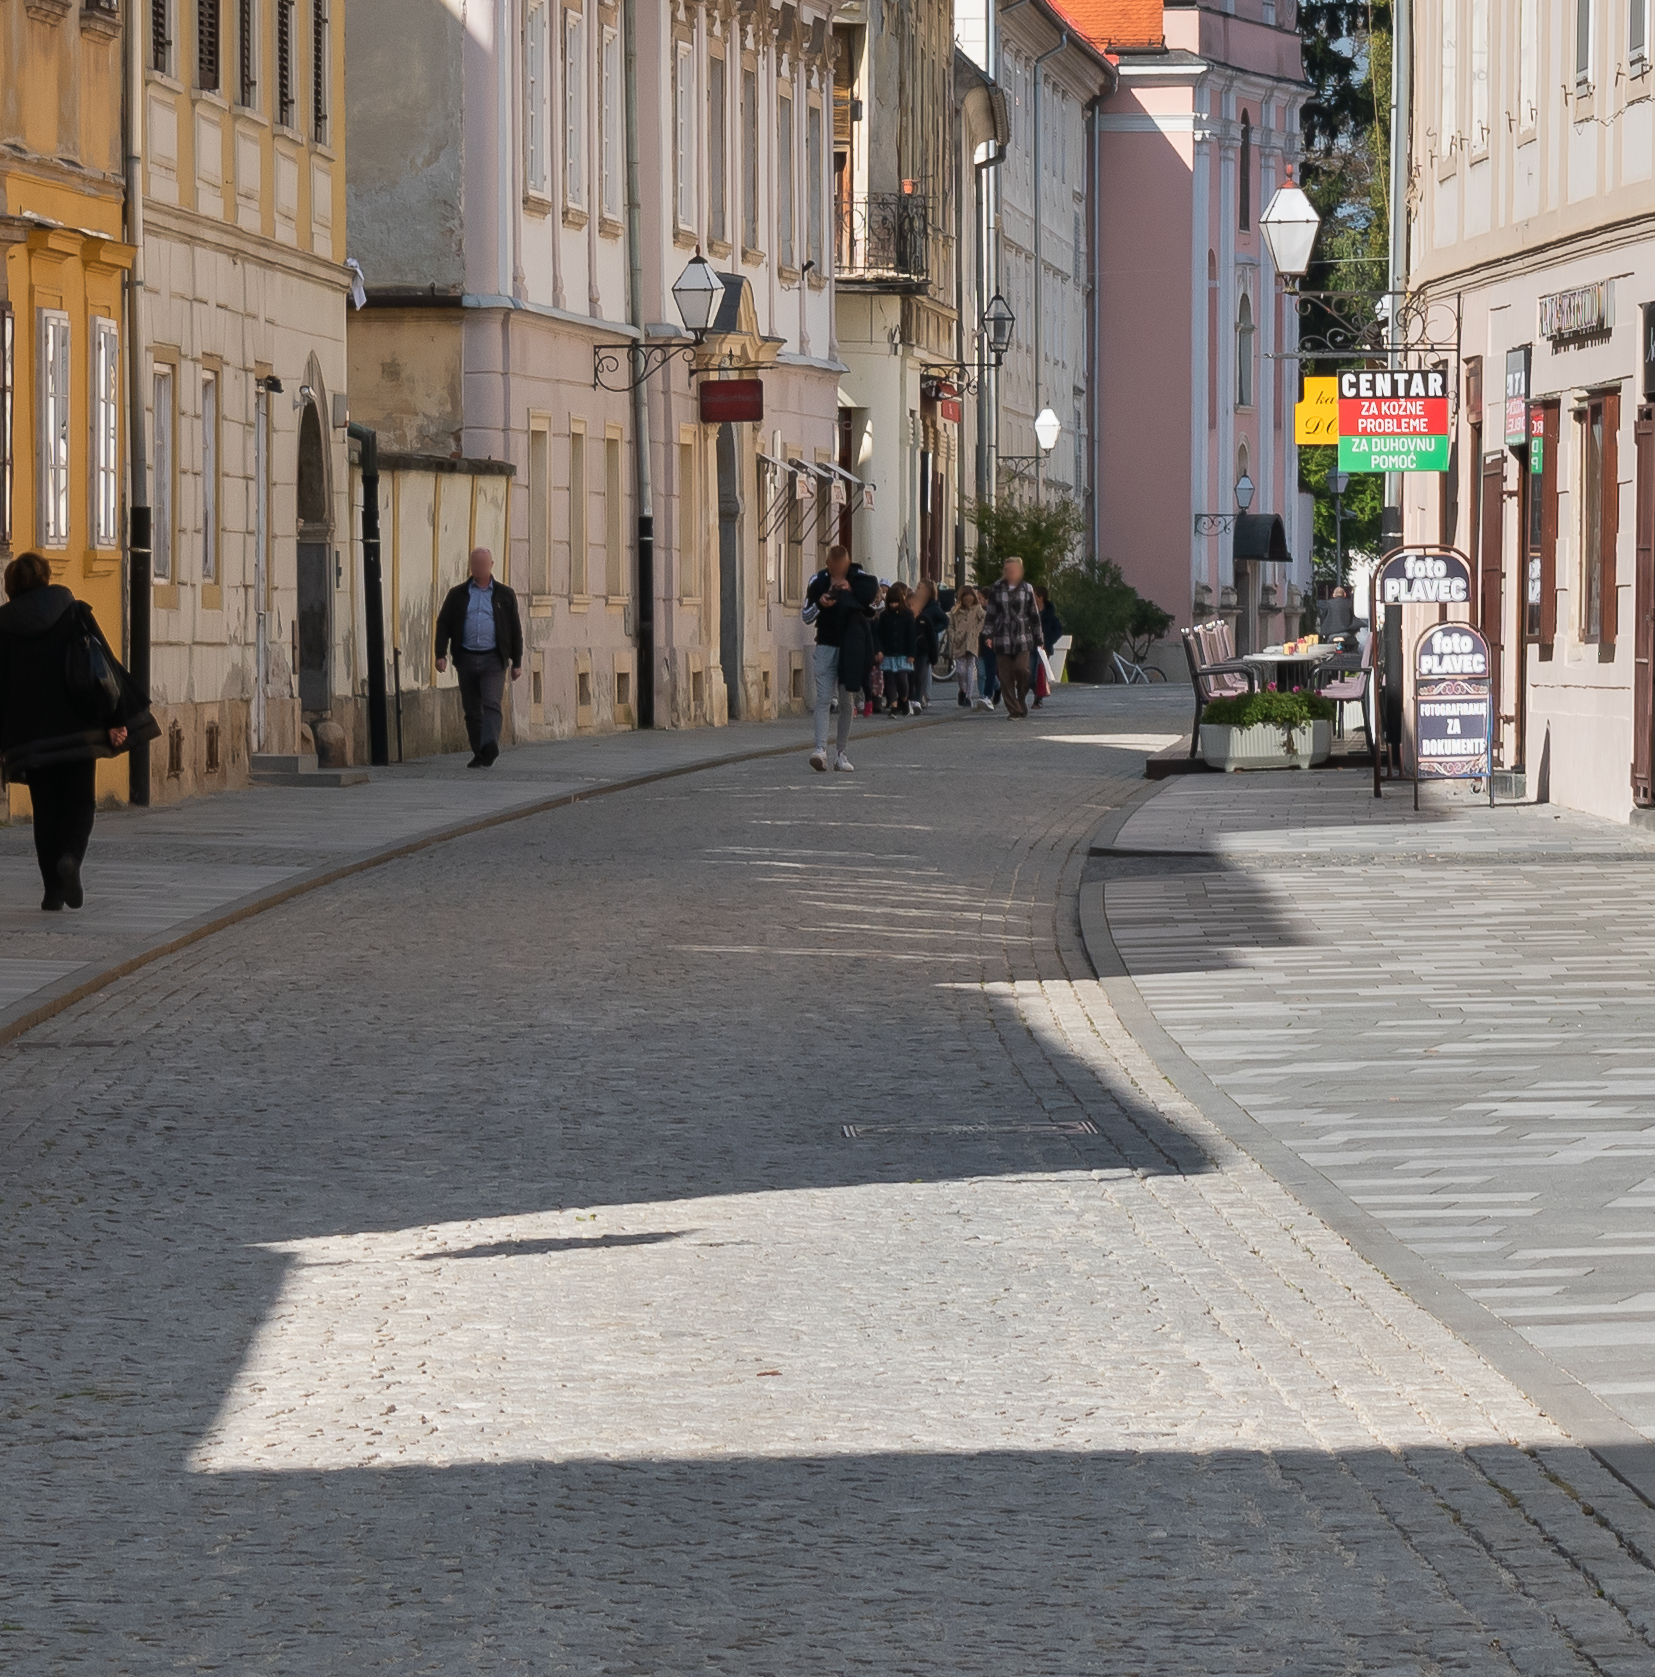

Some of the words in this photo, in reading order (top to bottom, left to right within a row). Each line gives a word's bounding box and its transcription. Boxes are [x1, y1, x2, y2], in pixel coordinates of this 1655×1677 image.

[1341, 372, 1443, 398] CENTAR
[1360, 401, 1379, 416] ZA
[1381, 398, 1425, 416] KOŽNE
[1357, 418, 1429, 433] PROBLEME
[1351, 438, 1369, 452] ZA
[1371, 437, 1435, 452] DUHOVNU
[1370, 452, 1417, 469] POMOĆ
[1404, 555, 1447, 579] foto
[1383, 577, 1468, 603] PLAVEC
[1431, 631, 1474, 654] foto
[1419, 653, 1486, 675] PLAVEC
[1446, 718, 1462, 735] ZA
